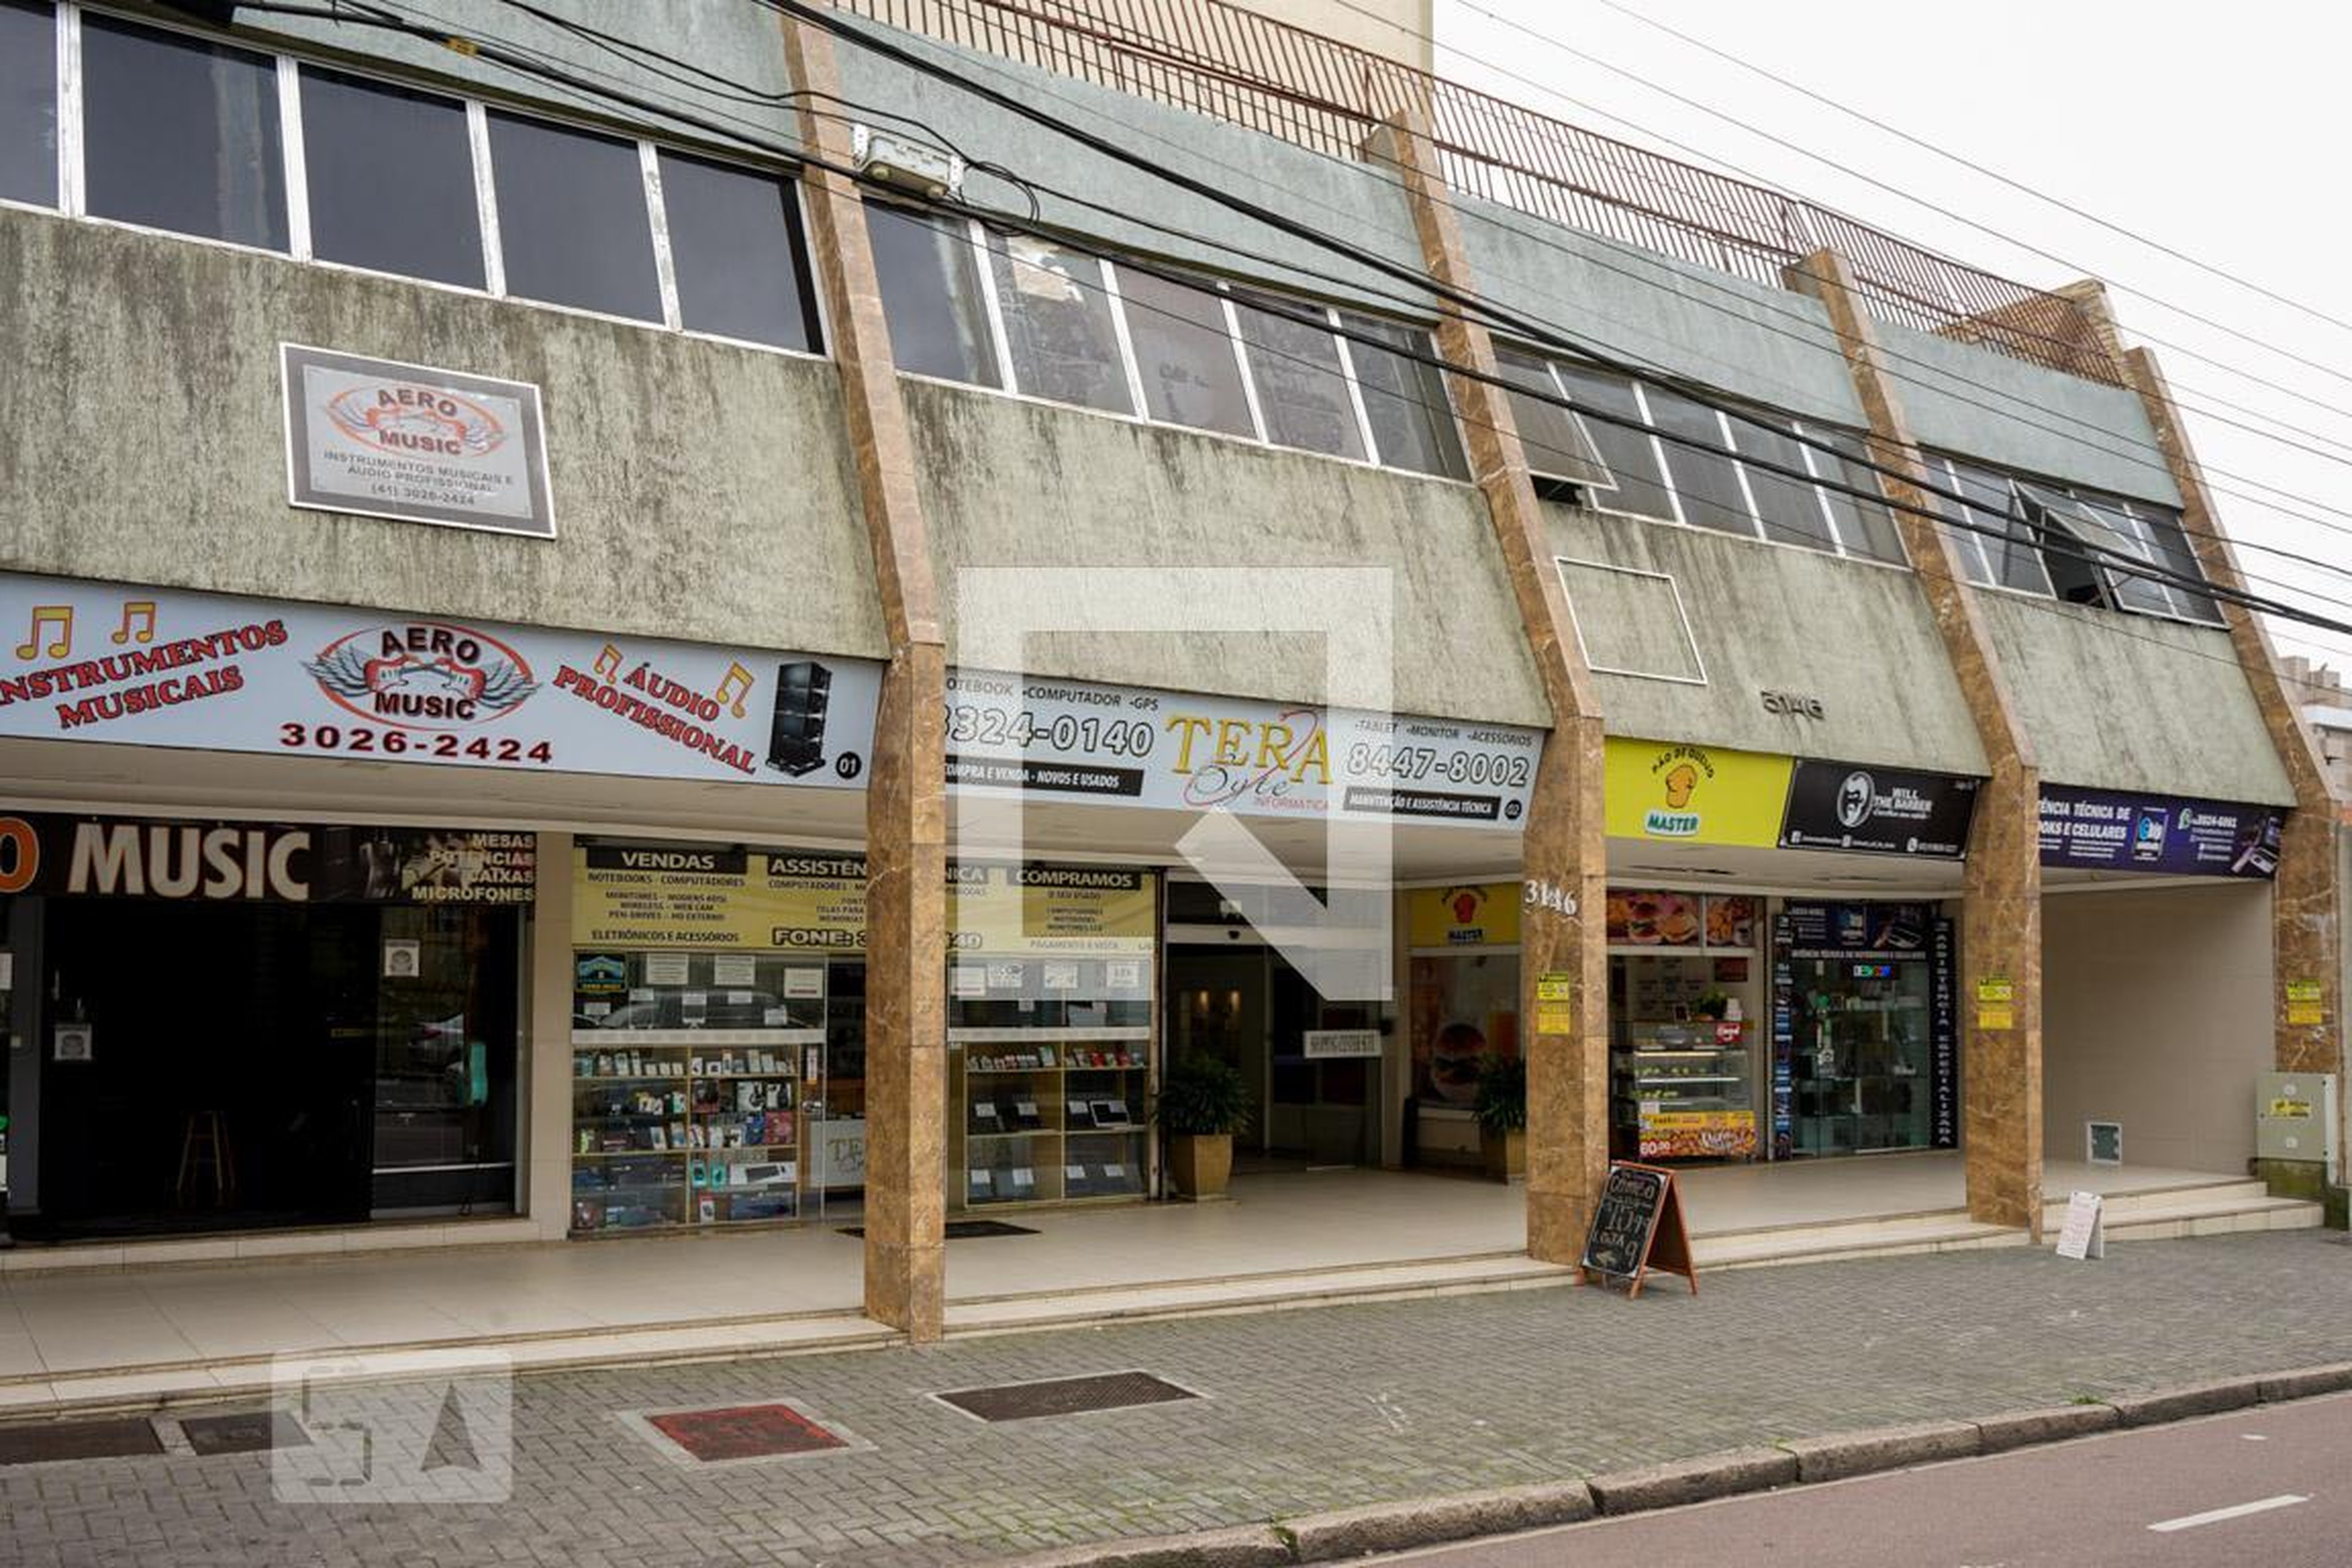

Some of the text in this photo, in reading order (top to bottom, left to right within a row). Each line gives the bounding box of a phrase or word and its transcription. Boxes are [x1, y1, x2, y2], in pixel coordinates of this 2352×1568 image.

[377, 388, 458, 417] AERO
[379, 431, 462, 456] MUSIC
[324, 451, 434, 476] INSTRUMENTOS
[439, 466, 505, 484] MUSICAIS
[381, 627, 481, 664] AERO
[0, 619, 288, 706] NSTRUMENTOS
[56, 665, 244, 729] MUSICAIS
[623, 662, 721, 723] ÁUDIO
[946, 677, 1013, 695] OTEBOOK
[374, 692, 477, 720] MUSIC
[553, 665, 757, 775] PROFISSIONAL
[281, 723, 552, 763] 3026-2424
[1166, 717, 1333, 785] TERA
[839, 756, 858, 774] 01
[1348, 742, 1530, 786] 8447-8002
[1036, 770, 1071, 785] NOVOS
[1072, 772, 1080, 786] E
[1080, 773, 1120, 788] USADOS
[2040, 797, 2132, 820] ÊNCIA TÉCNICA DE
[1647, 813, 1698, 831] MASTER
[2063, 822, 2071, 835] E
[2072, 823, 2127, 840] CELULARES
[472, 833, 534, 848] MESAS
[67, 821, 310, 901] MUSIC
[621, 852, 715, 869] VENDAS
[771, 858, 867, 876] ASSISTÊN
[588, 872, 745, 887] NOTEBOOKS COMPUTADORES
[1016, 869, 1134, 887] COMPRAMOS
[412, 886, 534, 902] MICROFONES
[1525, 880, 1577, 916] 3146
[592, 928, 666, 941] ELETRÔNICOS
[676, 930, 739, 942] ACESSÓRIOS
[772, 927, 854, 948] FONE:
